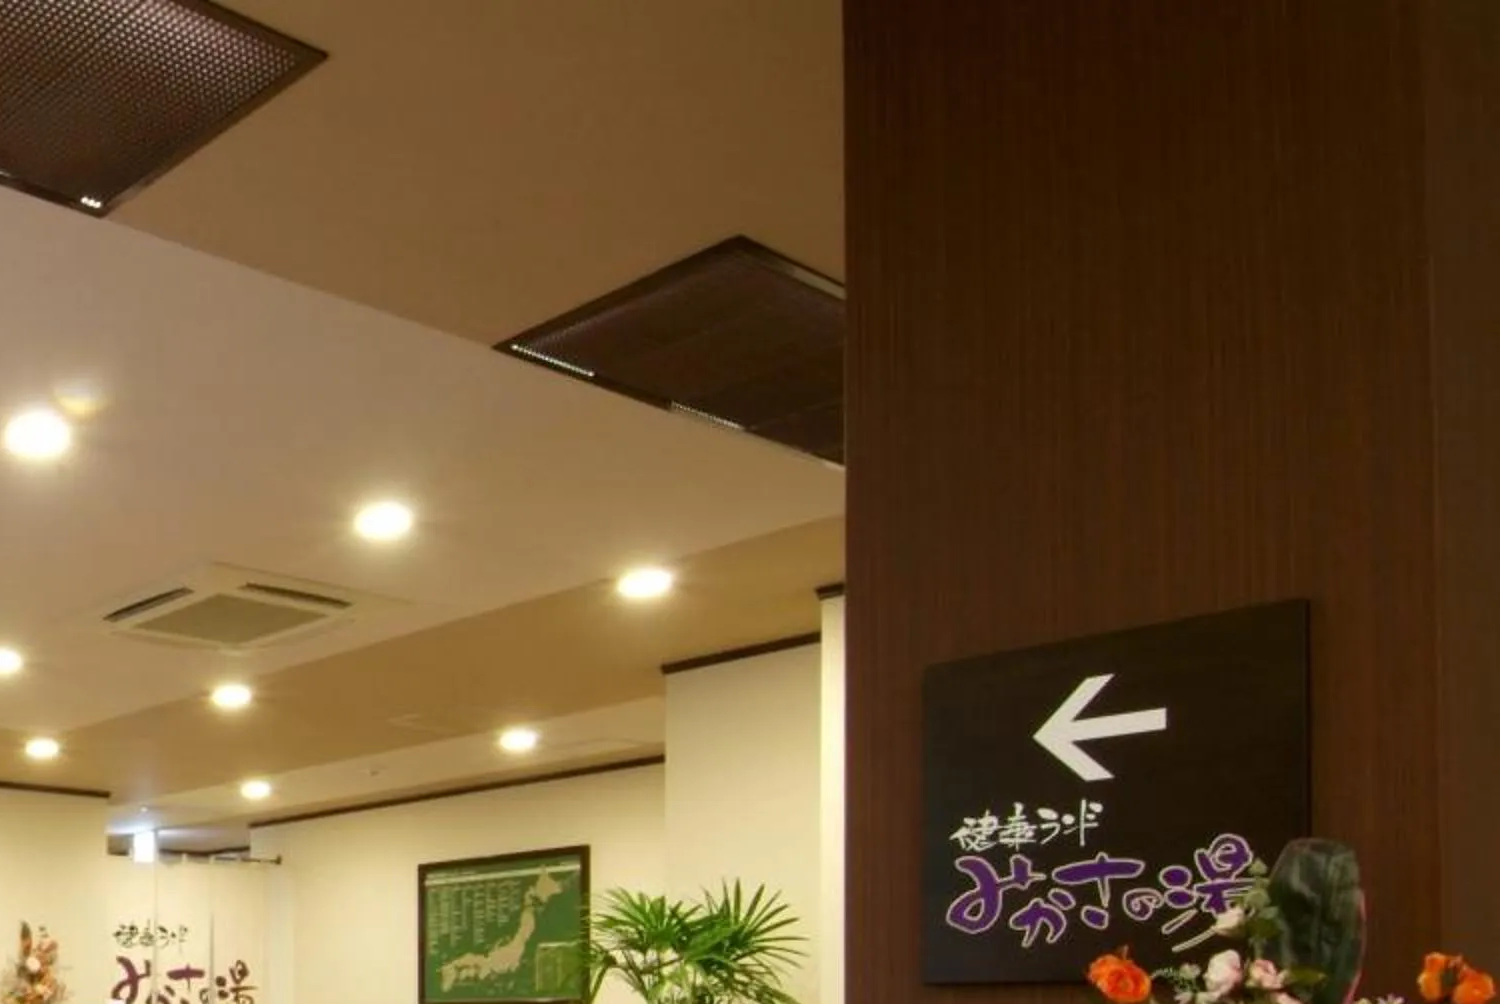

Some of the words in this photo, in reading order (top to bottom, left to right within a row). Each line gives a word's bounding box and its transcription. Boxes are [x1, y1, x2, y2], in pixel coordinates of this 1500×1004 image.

[949, 799, 1104, 851] 健康ランド
